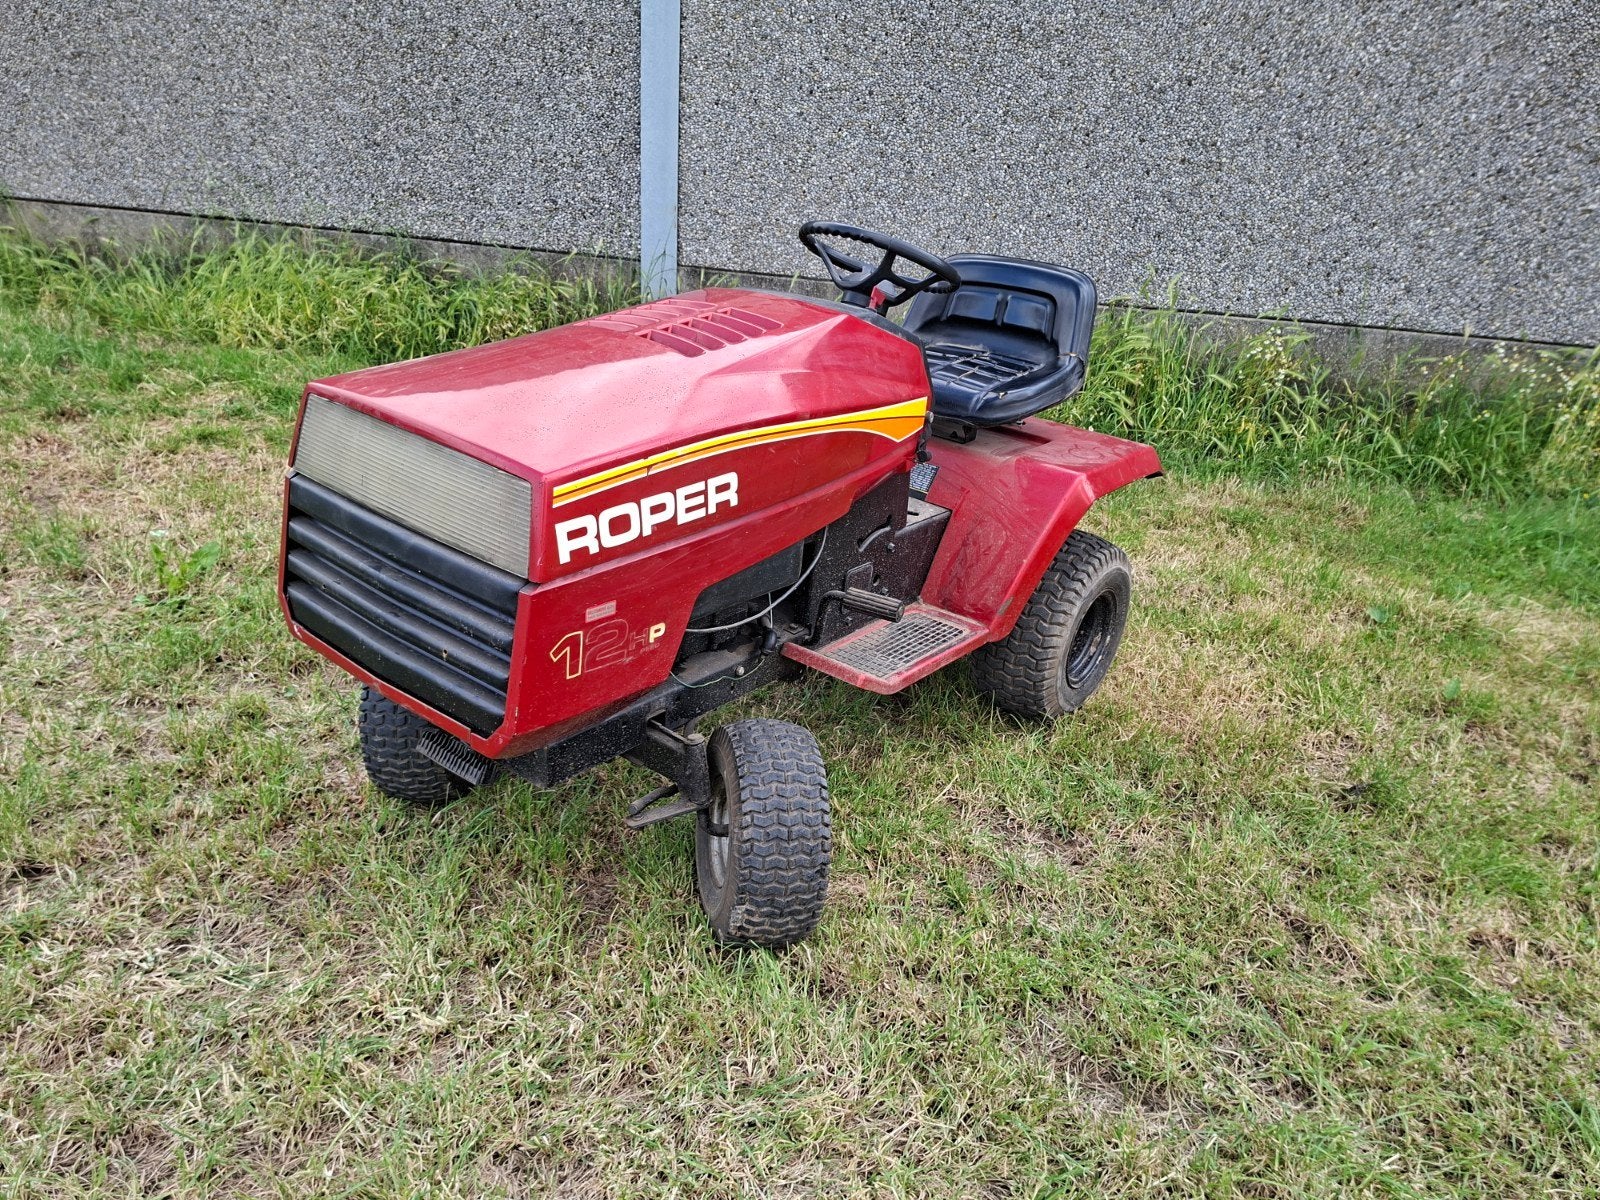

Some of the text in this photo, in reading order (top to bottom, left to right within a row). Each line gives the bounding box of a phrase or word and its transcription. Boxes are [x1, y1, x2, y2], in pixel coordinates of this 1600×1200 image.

[555, 471, 739, 565] ROPER
[549, 618, 666, 680] 12 HP
